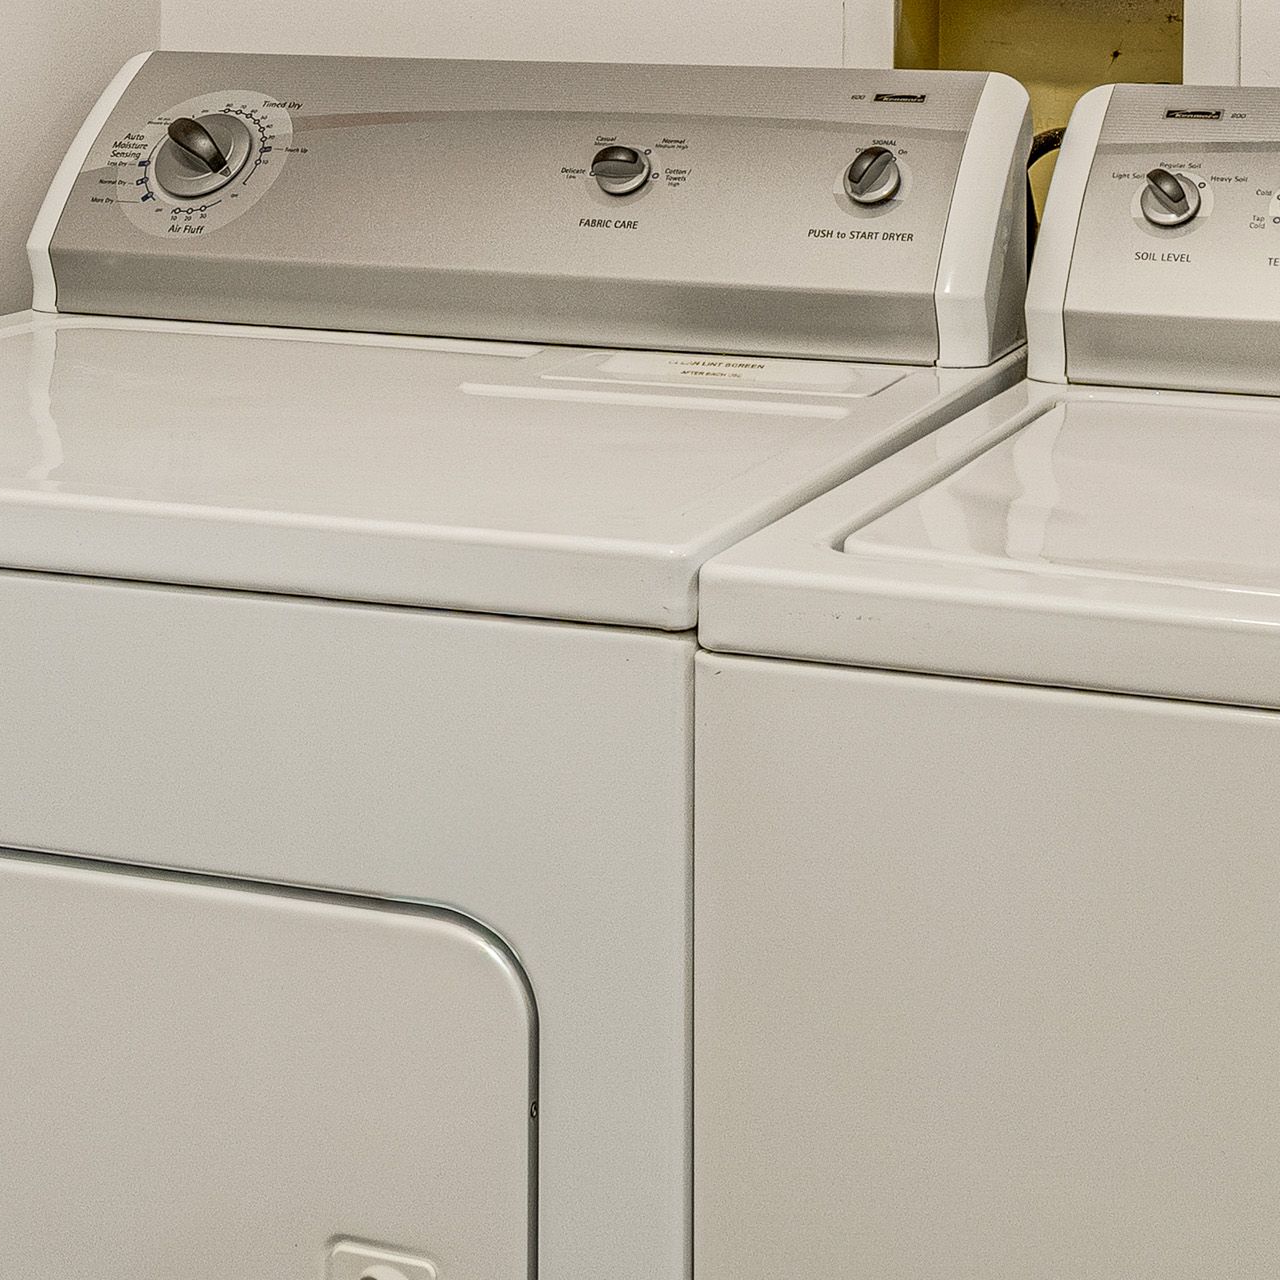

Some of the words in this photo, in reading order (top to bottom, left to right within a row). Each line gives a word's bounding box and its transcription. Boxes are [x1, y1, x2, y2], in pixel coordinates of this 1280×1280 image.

[263, 100, 286, 108] Timed
[111, 151, 141, 159] Sensing
[1211, 175, 1232, 184] Heavy
[579, 219, 611, 229] FABRIC
[614, 221, 638, 229] CARE
[185, 225, 204, 234] Fluff
[808, 229, 833, 238] PUSH
[849, 231, 879, 240] START
[882, 232, 914, 242] DRYER
[1135, 252, 1157, 261] SOIL
[1161, 253, 1191, 263] LEVEL
